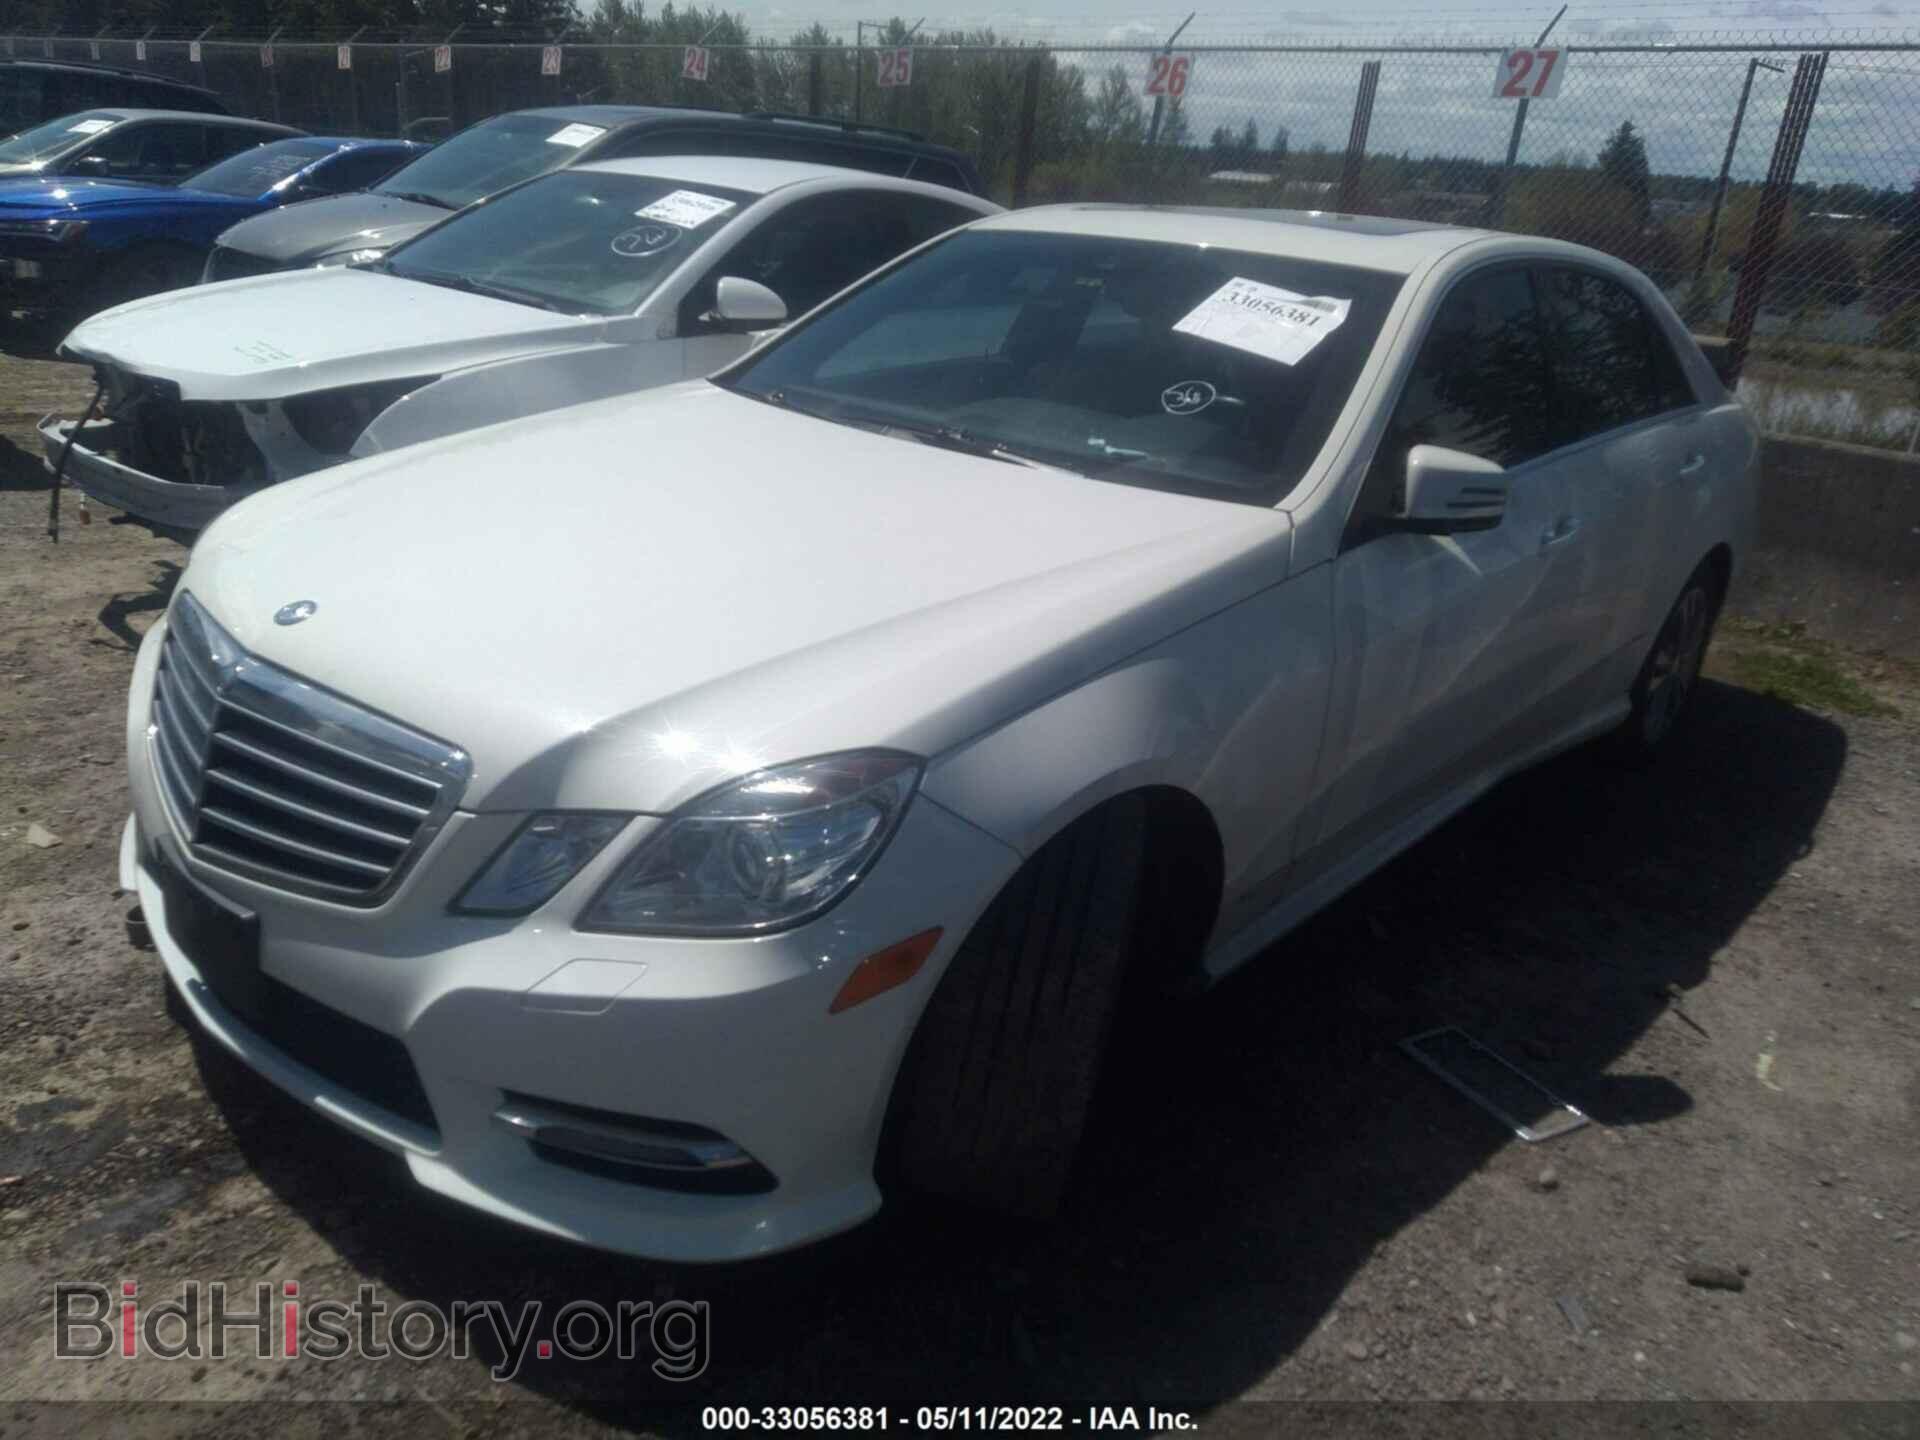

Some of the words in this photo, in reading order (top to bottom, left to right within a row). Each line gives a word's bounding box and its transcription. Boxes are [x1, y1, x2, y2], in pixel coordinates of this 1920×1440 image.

[436, 47, 449, 69] 22
[544, 49, 560, 73] 23
[685, 50, 708, 79] 24
[880, 50, 909, 84] 25
[1501, 50, 1559, 97] 27
[1148, 56, 1187, 95] 26
[1224, 291, 1320, 327] 33056381
